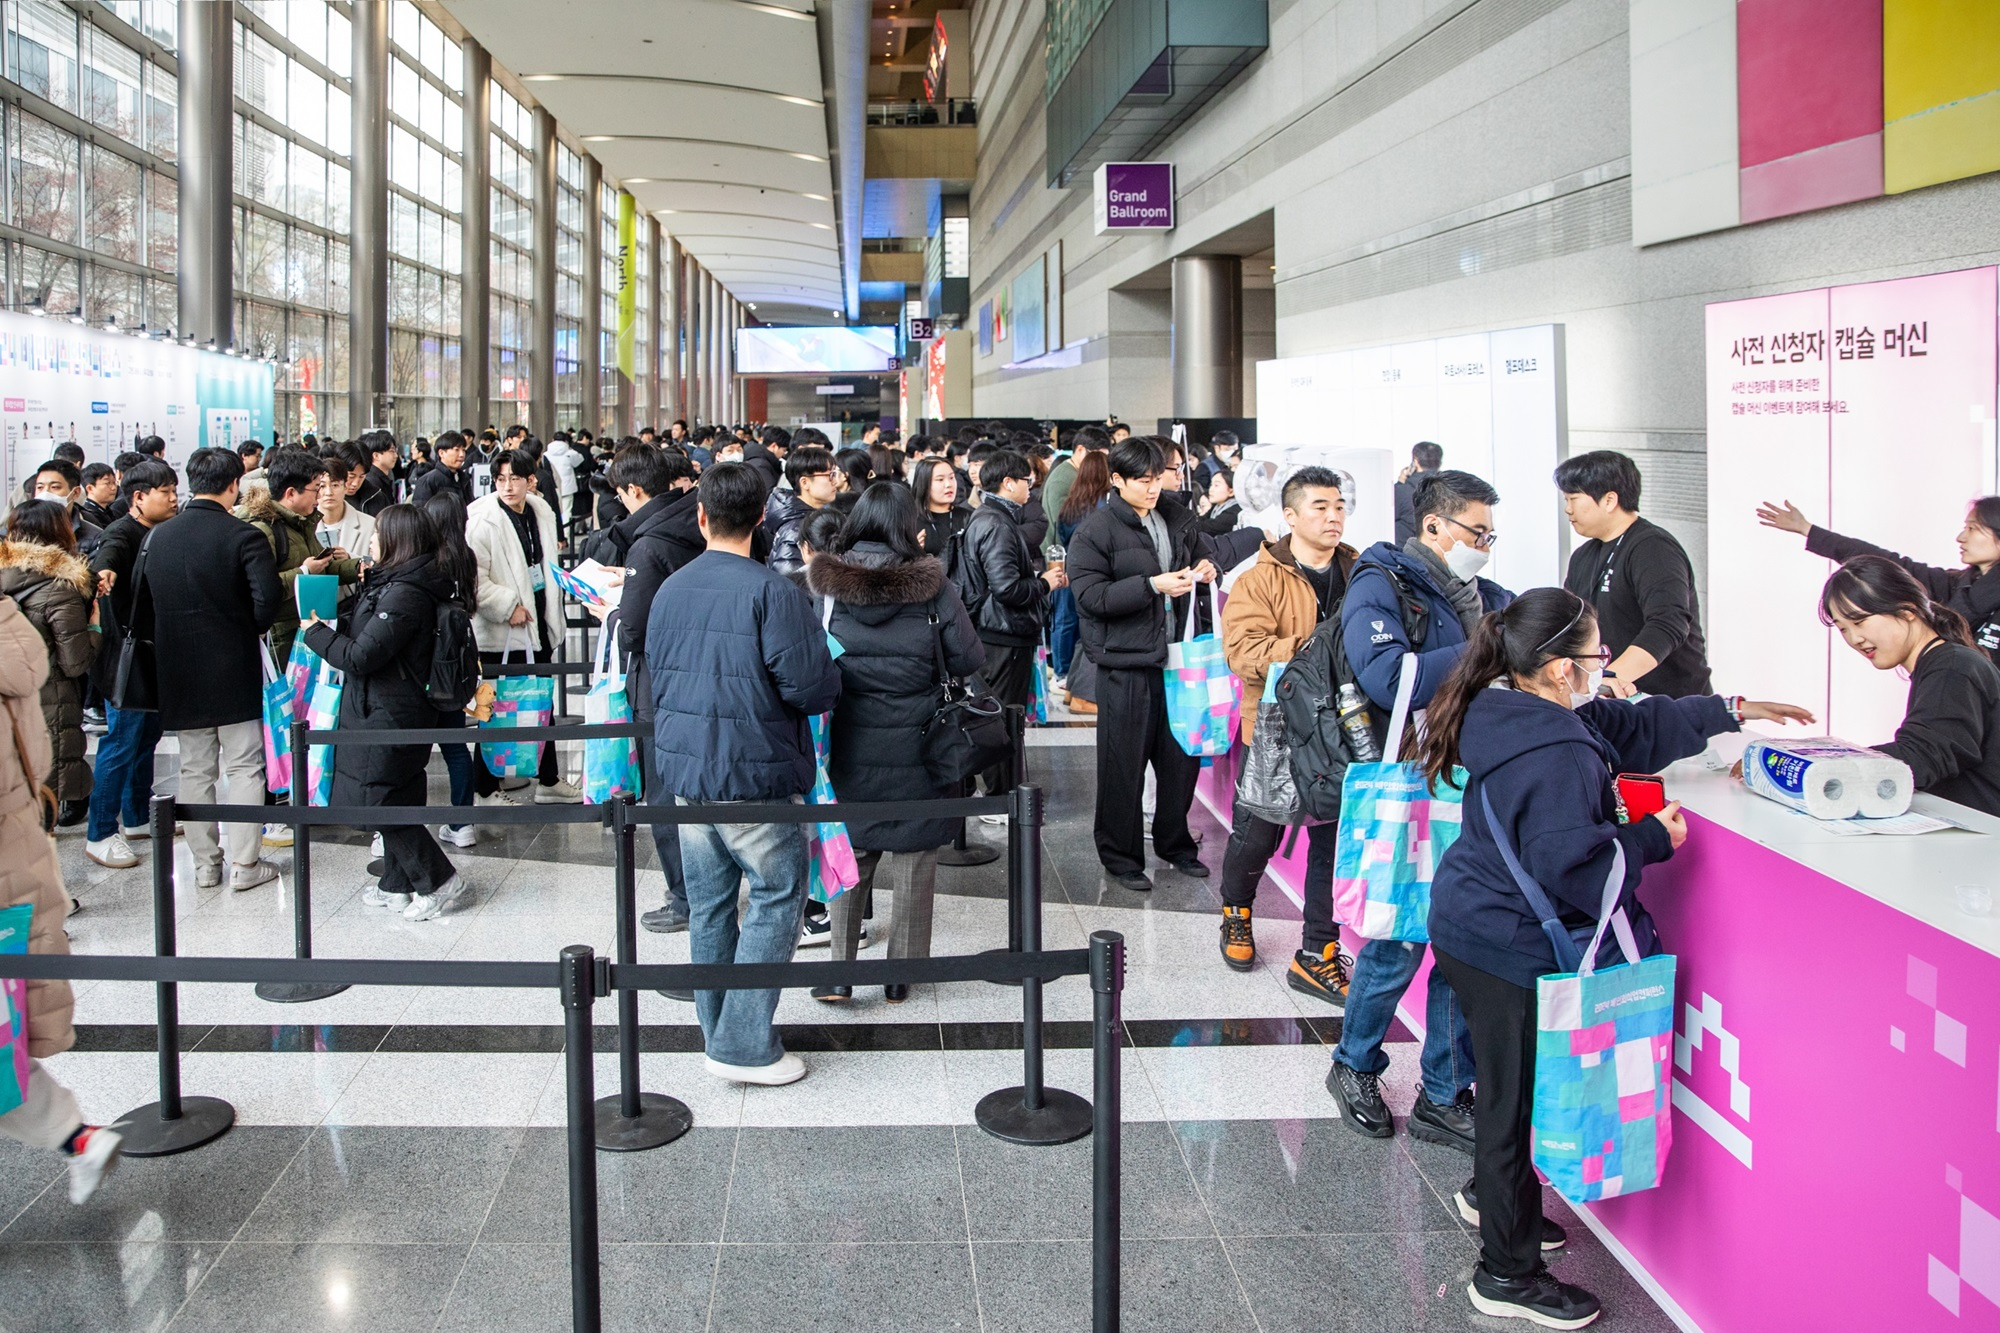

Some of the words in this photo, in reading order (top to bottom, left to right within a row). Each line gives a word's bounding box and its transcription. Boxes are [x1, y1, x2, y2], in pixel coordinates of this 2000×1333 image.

[1109, 189, 1147, 202] Grand
[1109, 205, 1168, 218] Ballroom
[912, 321, 932, 337] B2
[1731, 335, 1764, 366] 사전
[1770, 329, 1825, 364] 신청자
[1835, 326, 1876, 360] 캡슐
[1884, 321, 1928, 357] 머신
[1731, 381, 1745, 394] 사전
[1747, 379, 1776, 394] 신청자를
[1778, 379, 1793, 393] 위해
[1796, 378, 1820, 392] 준비한
[1731, 401, 1745, 415] 캡슐
[1747, 401, 1761, 415] 머신
[1763, 400, 1793, 415] 이벤트에
[1795, 400, 1819, 415] 참여해
